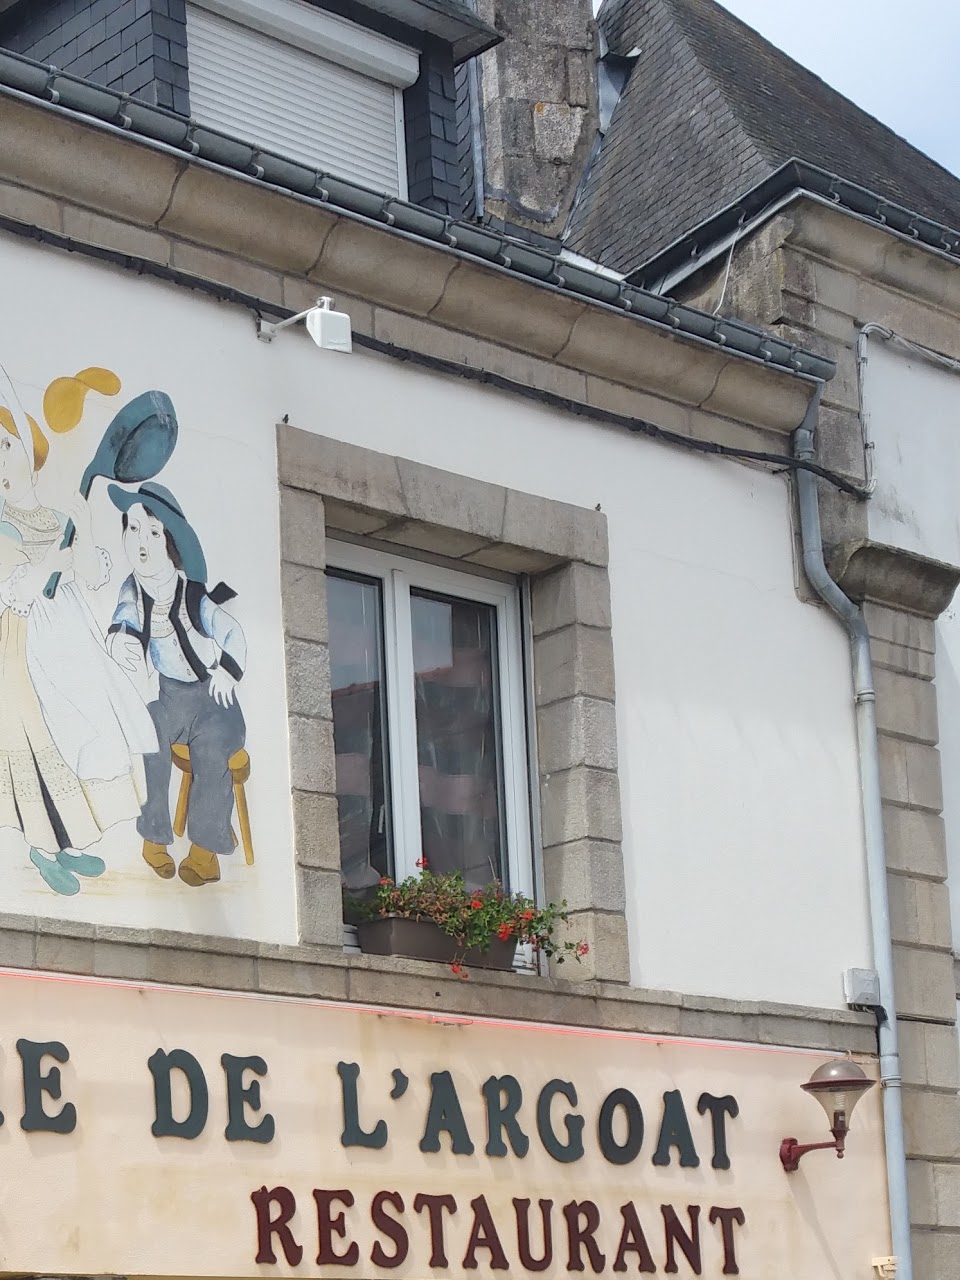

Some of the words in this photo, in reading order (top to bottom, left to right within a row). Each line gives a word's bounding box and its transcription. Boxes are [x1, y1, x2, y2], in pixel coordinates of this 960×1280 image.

[147, 1047, 276, 1144] DE
[336, 1060, 740, 1170] L'ARGOAT
[250, 1185, 746, 1275] RESTAURANT
